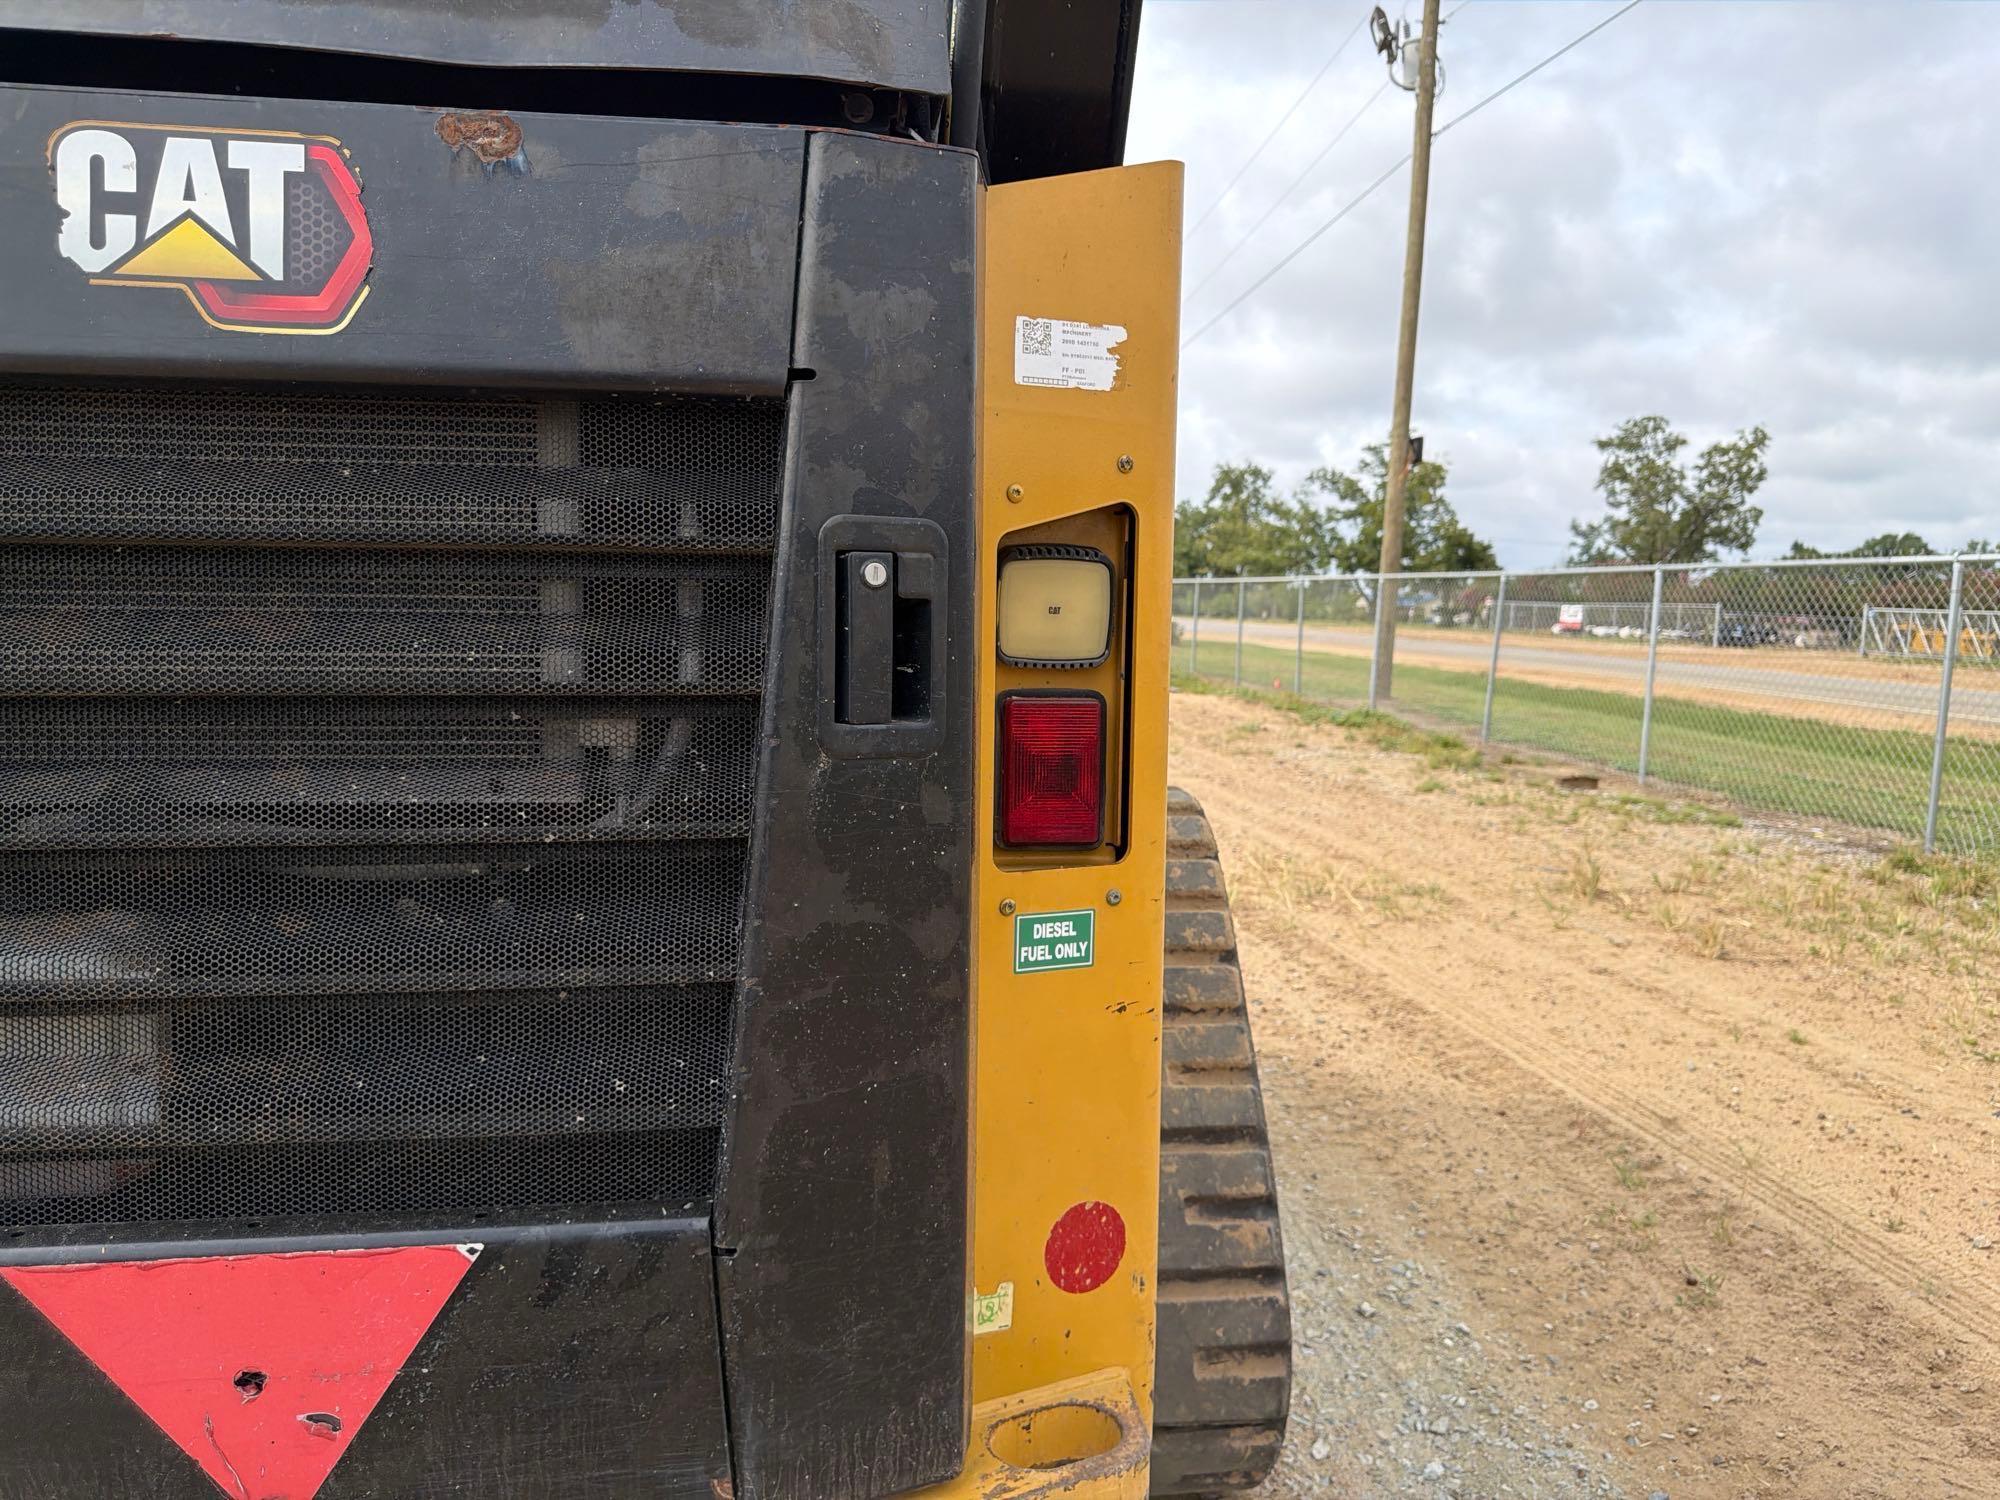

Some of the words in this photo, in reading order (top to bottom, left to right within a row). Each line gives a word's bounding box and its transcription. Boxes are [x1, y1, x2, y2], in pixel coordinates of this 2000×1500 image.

[56, 129, 306, 281] CAT
[1048, 606, 1062, 615] CAT
[1033, 921, 1077, 939] DIESEL
[1020, 944, 1053, 962] FUEL
[1054, 941, 1088, 959] ONLY
